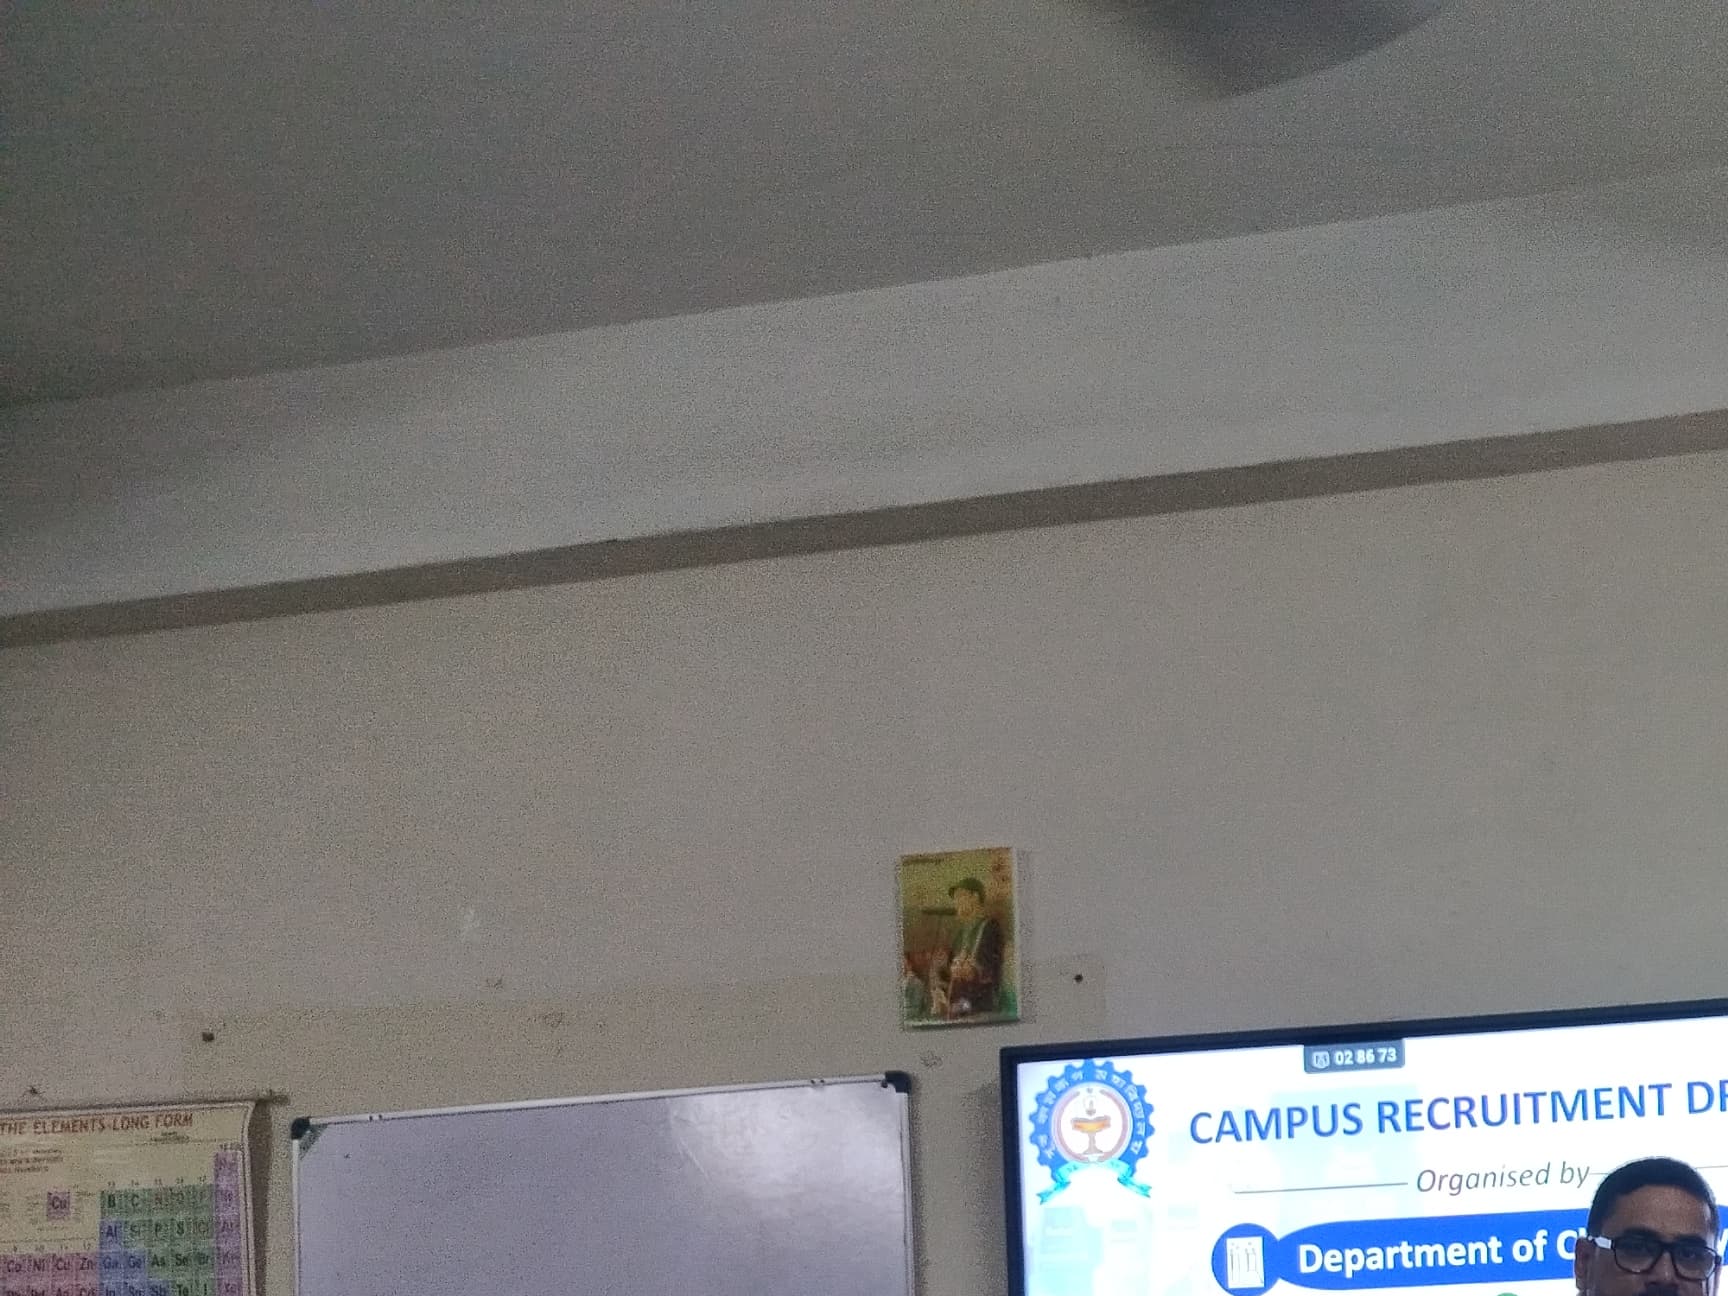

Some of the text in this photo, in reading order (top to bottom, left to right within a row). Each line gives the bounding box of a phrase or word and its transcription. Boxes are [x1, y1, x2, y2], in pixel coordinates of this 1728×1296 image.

[1335, 1049, 1354, 1066] 02
[1376, 1046, 1397, 1063] 73
[0, 1121, 26, 1136] THE
[155, 1113, 192, 1128] FORM
[1190, 1102, 1364, 1144] CAMPUS
[1378, 1083, 1672, 1133] RECRUITMENT
[1416, 1161, 1590, 1196] Organised by
[80, 1257, 94, 1270] Zn
[1299, 1234, 1504, 1278] Department
[1512, 1229, 1549, 1263] of
